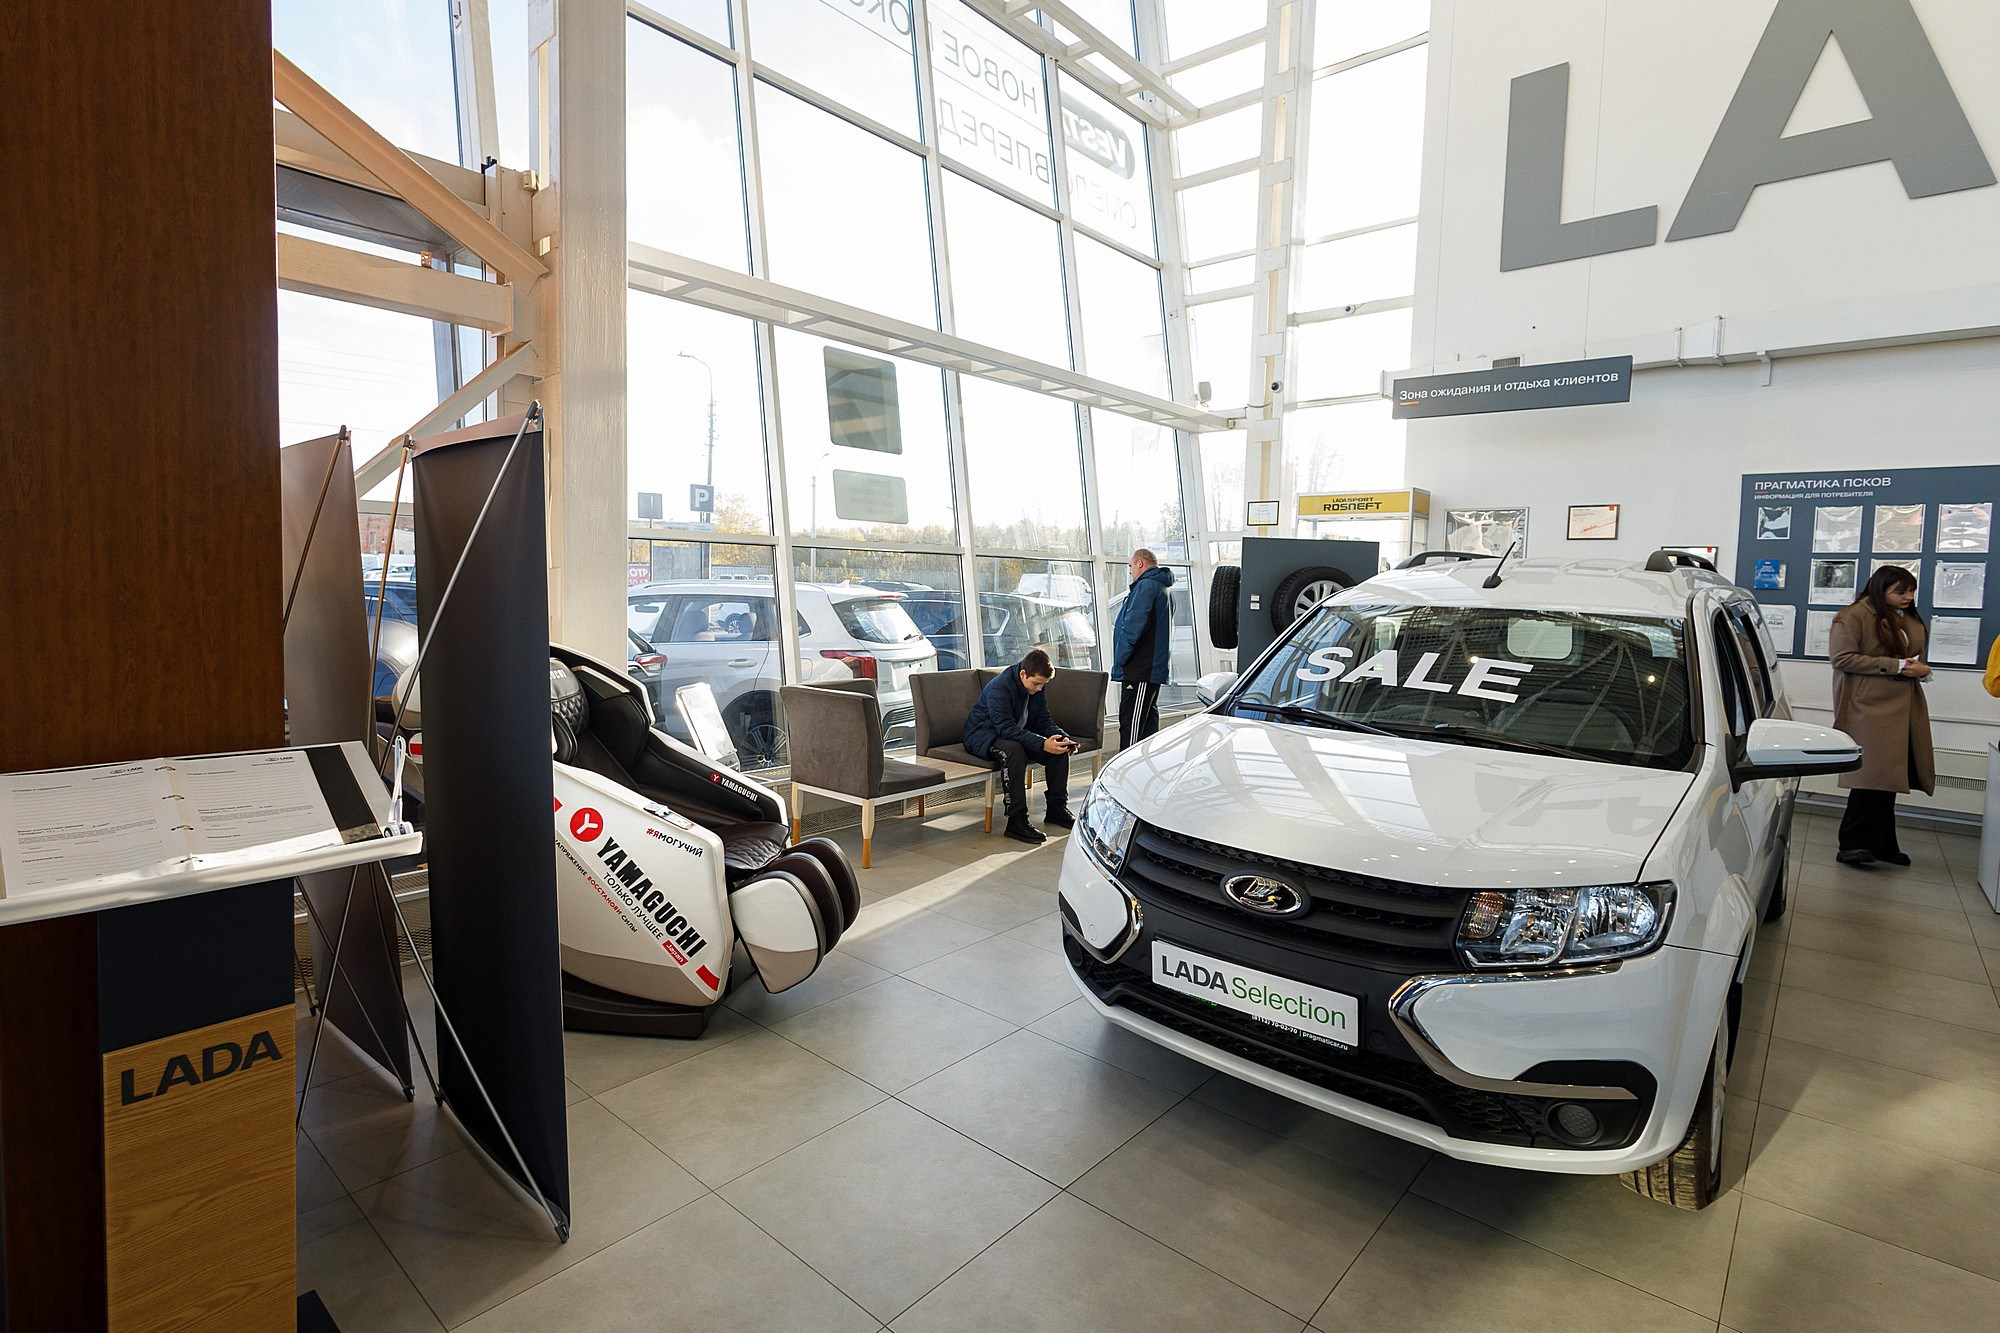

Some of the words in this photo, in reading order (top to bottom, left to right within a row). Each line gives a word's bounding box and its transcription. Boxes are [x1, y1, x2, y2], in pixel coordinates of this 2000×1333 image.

[1500, 0, 1998, 272] LA
[1399, 389, 1429, 401] Зона
[1430, 383, 1491, 399] ожидания
[1493, 383, 1502, 393] и
[1504, 378, 1551, 392] отдыха
[1553, 372, 1619, 387] клиентов
[1755, 479, 1841, 491] ПРАГМАТИКА
[1843, 477, 1892, 488] ПСКОВ
[1821, 491, 1874, 499] ПОТРЕБИТЕЛЯ
[1323, 501, 1383, 512] ROSNEFT
[1296, 646, 1535, 704] SALE
[721, 777, 758, 802] YAMAGUCHI
[646, 827, 703, 858] #ЯМОГУЧИЙ
[555, 839, 588, 876] АПРЯЖЕНИЕ
[587, 876, 622, 915] ВОССТАНОВИ
[621, 914, 638, 933] СИЛЫ
[596, 836, 708, 958] YAMAGUCHI
[603, 872, 634, 907] ТОЛЬКО
[631, 906, 664, 940] ЛУЧШЕЕ
[666, 944, 684, 963] Japan
[1161, 954, 1229, 994] LADA
[1231, 976, 1346, 1030] Selection
[1271, 1019, 1298, 1034] 70-02-70
[1302, 1030, 1349, 1051] pragmaticar.ru
[121, 1030, 283, 1107] LADA
